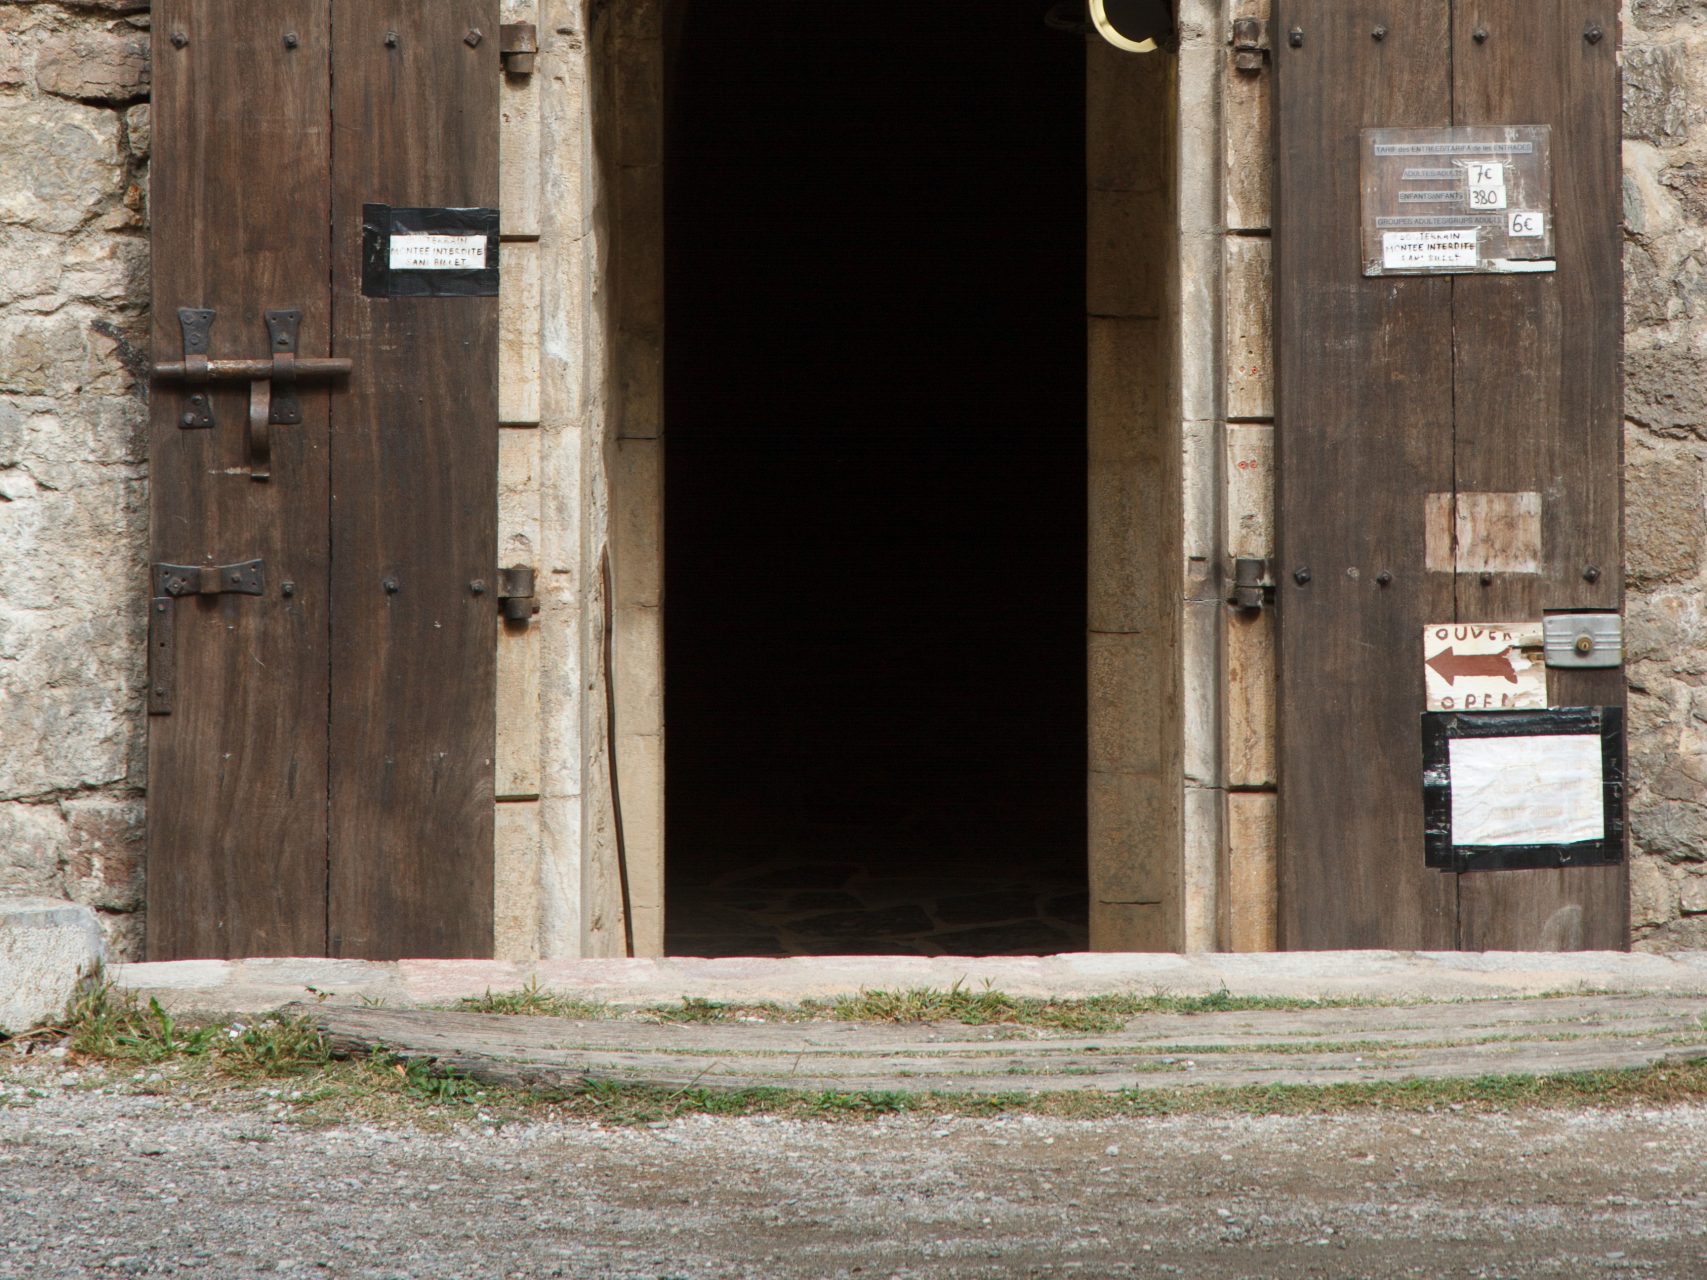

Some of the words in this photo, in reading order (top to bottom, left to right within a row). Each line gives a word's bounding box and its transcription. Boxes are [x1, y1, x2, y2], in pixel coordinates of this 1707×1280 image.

[1512, 213, 1533, 233] 6€
[1427, 242, 1475, 251] INTERDITE
[1435, 626, 1512, 641] OUVER
